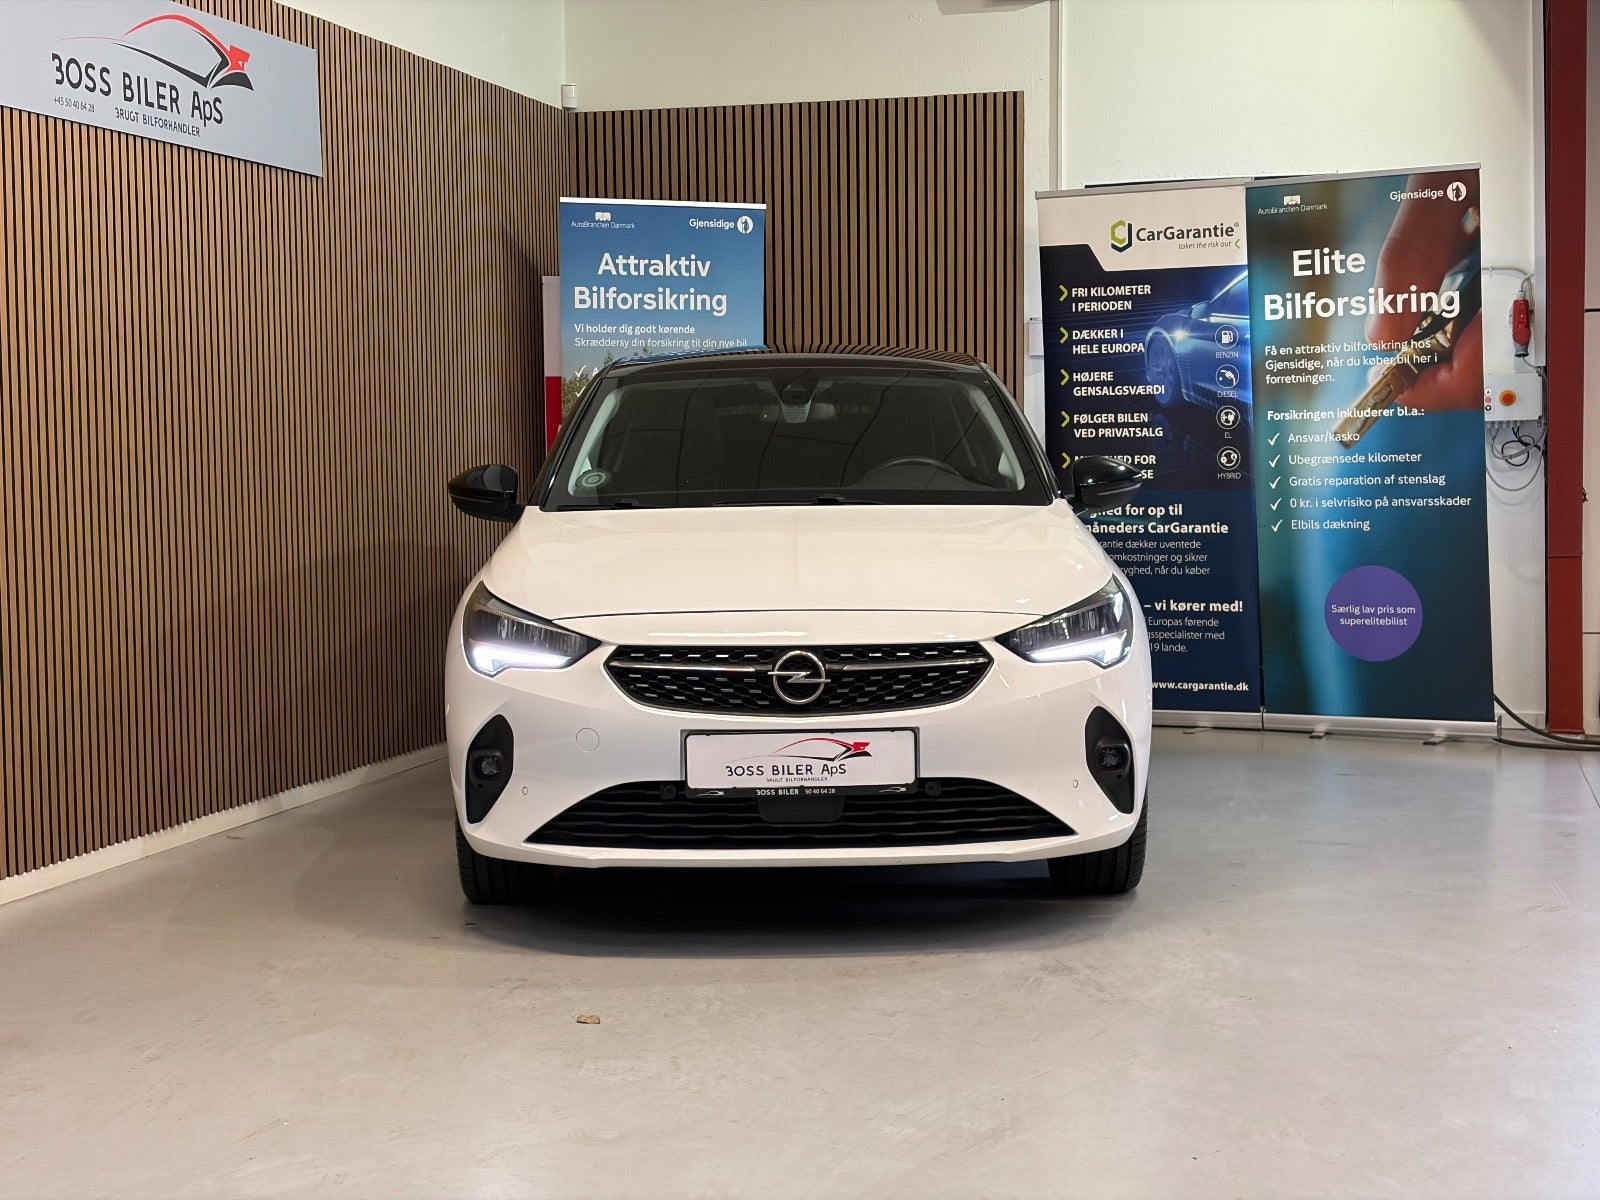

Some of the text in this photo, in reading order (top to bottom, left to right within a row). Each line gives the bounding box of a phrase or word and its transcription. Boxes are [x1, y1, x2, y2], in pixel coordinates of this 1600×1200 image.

[53, 97, 64, 106] +45
[73, 100, 80, 110] 40
[122, 72, 181, 115] BILER
[190, 90, 224, 128] ApS
[142, 114, 201, 137] BILFORHANDLER
[1389, 189, 1444, 202] Gjensidige
[1301, 203, 1328, 212] Danmark
[611, 221, 635, 229] Danmark
[689, 218, 735, 230] Gjensidige
[597, 252, 711, 277] Attraktiv
[1293, 247, 1366, 277] Elite
[1071, 285, 1151, 298] FRI KILOMETER
[574, 286, 728, 317] Bilforsikring
[1078, 301, 1132, 312] PERIODEN
[1264, 285, 1460, 321] Bilforsikring
[574, 323, 695, 336] Vi holder dig godt kørende
[1072, 330, 1118, 340] DÆKKER
[574, 337, 629, 349] Skræddersy
[631, 338, 645, 347] din
[647, 338, 690, 349] forsikring
[691, 338, 701, 347] til
[703, 338, 716, 347] din
[719, 340, 735, 348] nye
[1073, 343, 1145, 354] HELE EUROPA
[1265, 339, 1431, 356] Få en attraktiv bilforsikring hos
[1265, 358, 1324, 372] Gjensidige,
[1326, 356, 1344, 367] når
[1347, 357, 1360, 366] du
[1363, 356, 1394, 366] køber
[1397, 355, 1410, 364] bil
[1413, 353, 1432, 364] her
[1073, 371, 1114, 382] HØJERE
[1266, 373, 1335, 385] forretningen.
[1073, 385, 1165, 396] GENSALGSVÆRDI
[1074, 413, 1148, 424] FØLGER BILEN
[1267, 407, 1425, 422] Forsikringen inkluderer bl.a.:
[1074, 427, 1164, 438] VED PRIVATSALG
[1288, 431, 1360, 444] Ansvar/kasko
[1134, 455, 1156, 464] FOR
[1288, 453, 1422, 467] Ubegrænsede kilometer
[1217, 472, 1241, 480] HYBRID
[1289, 474, 1446, 488] Gratis reparation af stenslag
[1290, 498, 1297, 508] 0
[1300, 498, 1312, 508] kr.
[1321, 497, 1372, 508] selvrisiko
[1375, 496, 1388, 510] på
[1391, 496, 1471, 507] ansvarsskader
[1125, 503, 1145, 516] for
[1148, 506, 1165, 518] op
[1169, 504, 1183, 516] til
[1148, 522, 1229, 534] CarGarantie
[1291, 519, 1370, 531] Elbils dækning
[1125, 540, 1158, 549] dækker
[1160, 541, 1202, 549] uventede
[1171, 554, 1182, 563] og
[1184, 553, 1208, 562] sikrer
[1154, 566, 1169, 575] når
[1171, 566, 1182, 575] du
[1185, 566, 1211, 575] køber
[1154, 599, 1167, 611] vi
[1170, 599, 1206, 612] kører
[1209, 600, 1243, 612] med!
[1331, 604, 1361, 615] Særlig
[1362, 605, 1375, 614] lav
[1377, 605, 1394, 615] pris
[1148, 617, 1219, 628] Europas førende
[1340, 617, 1408, 626] superelitebilist
[1205, 631, 1225, 640] med
[1150, 642, 1188, 652] 19 lande.
[1152, 682, 1249, 691] www.cargarantie.dk
[772, 764, 813, 776] BILER
[821, 764, 847, 777] ApS
[778, 788, 799, 796] BILER
